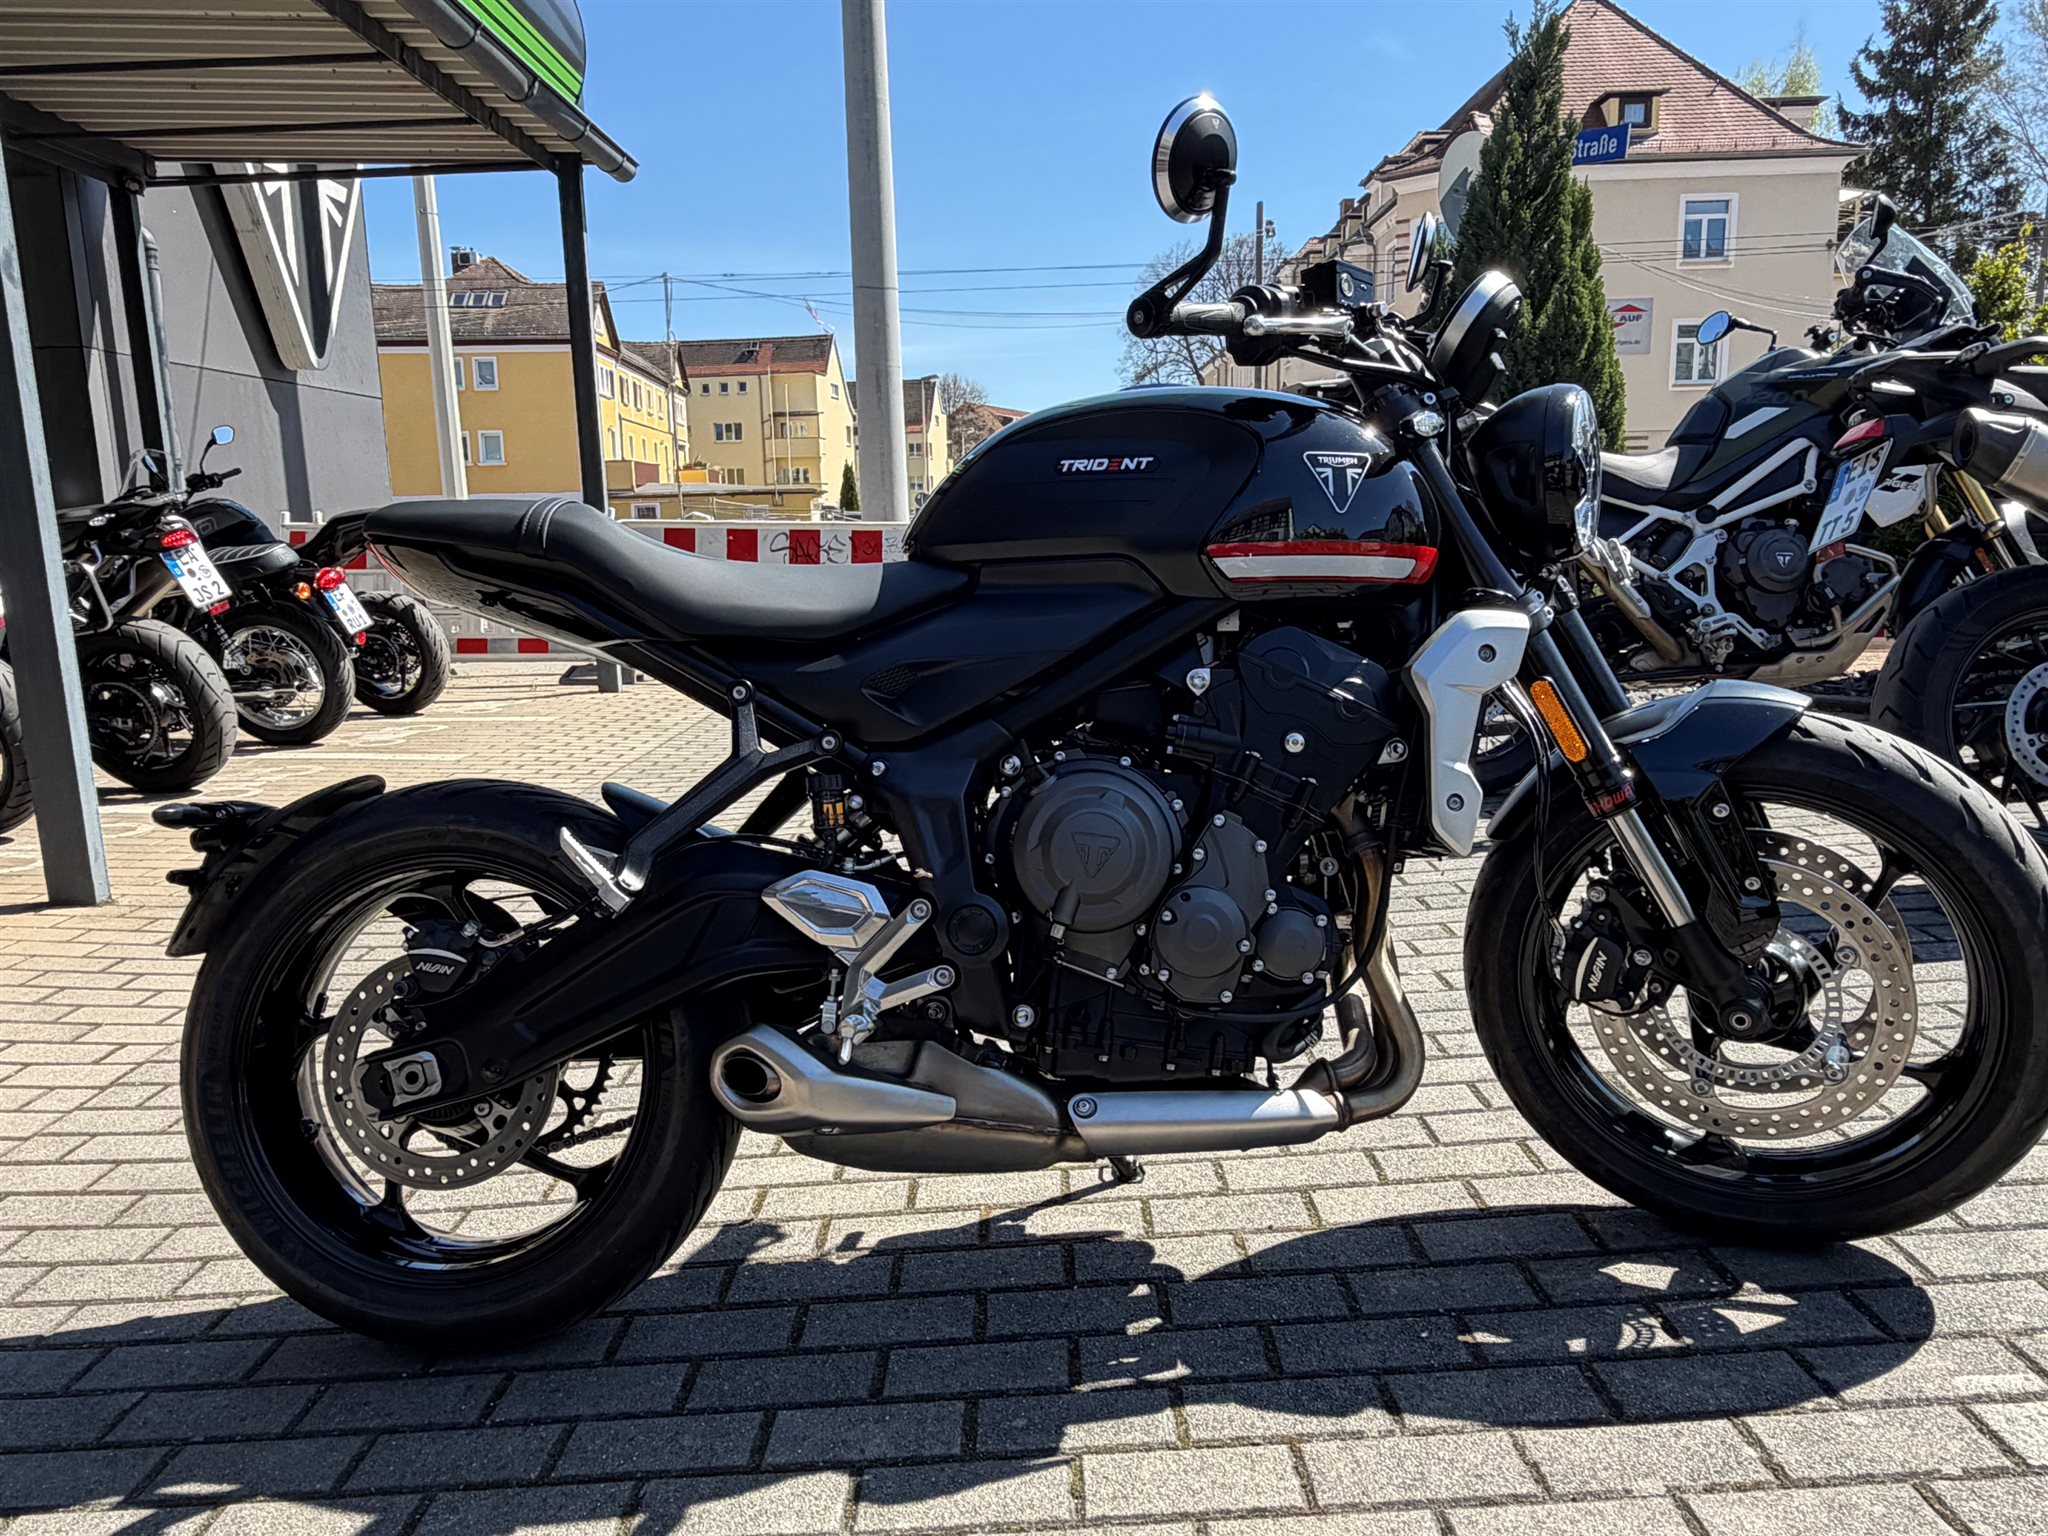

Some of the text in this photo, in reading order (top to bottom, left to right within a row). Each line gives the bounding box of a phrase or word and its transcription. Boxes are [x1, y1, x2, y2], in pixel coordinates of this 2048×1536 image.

[1060, 456, 1154, 473] TRIDENT
[1317, 456, 1358, 468] TRIUMPH
[1817, 506, 1859, 545] TT 5
[192, 580, 225, 603] JS 2
